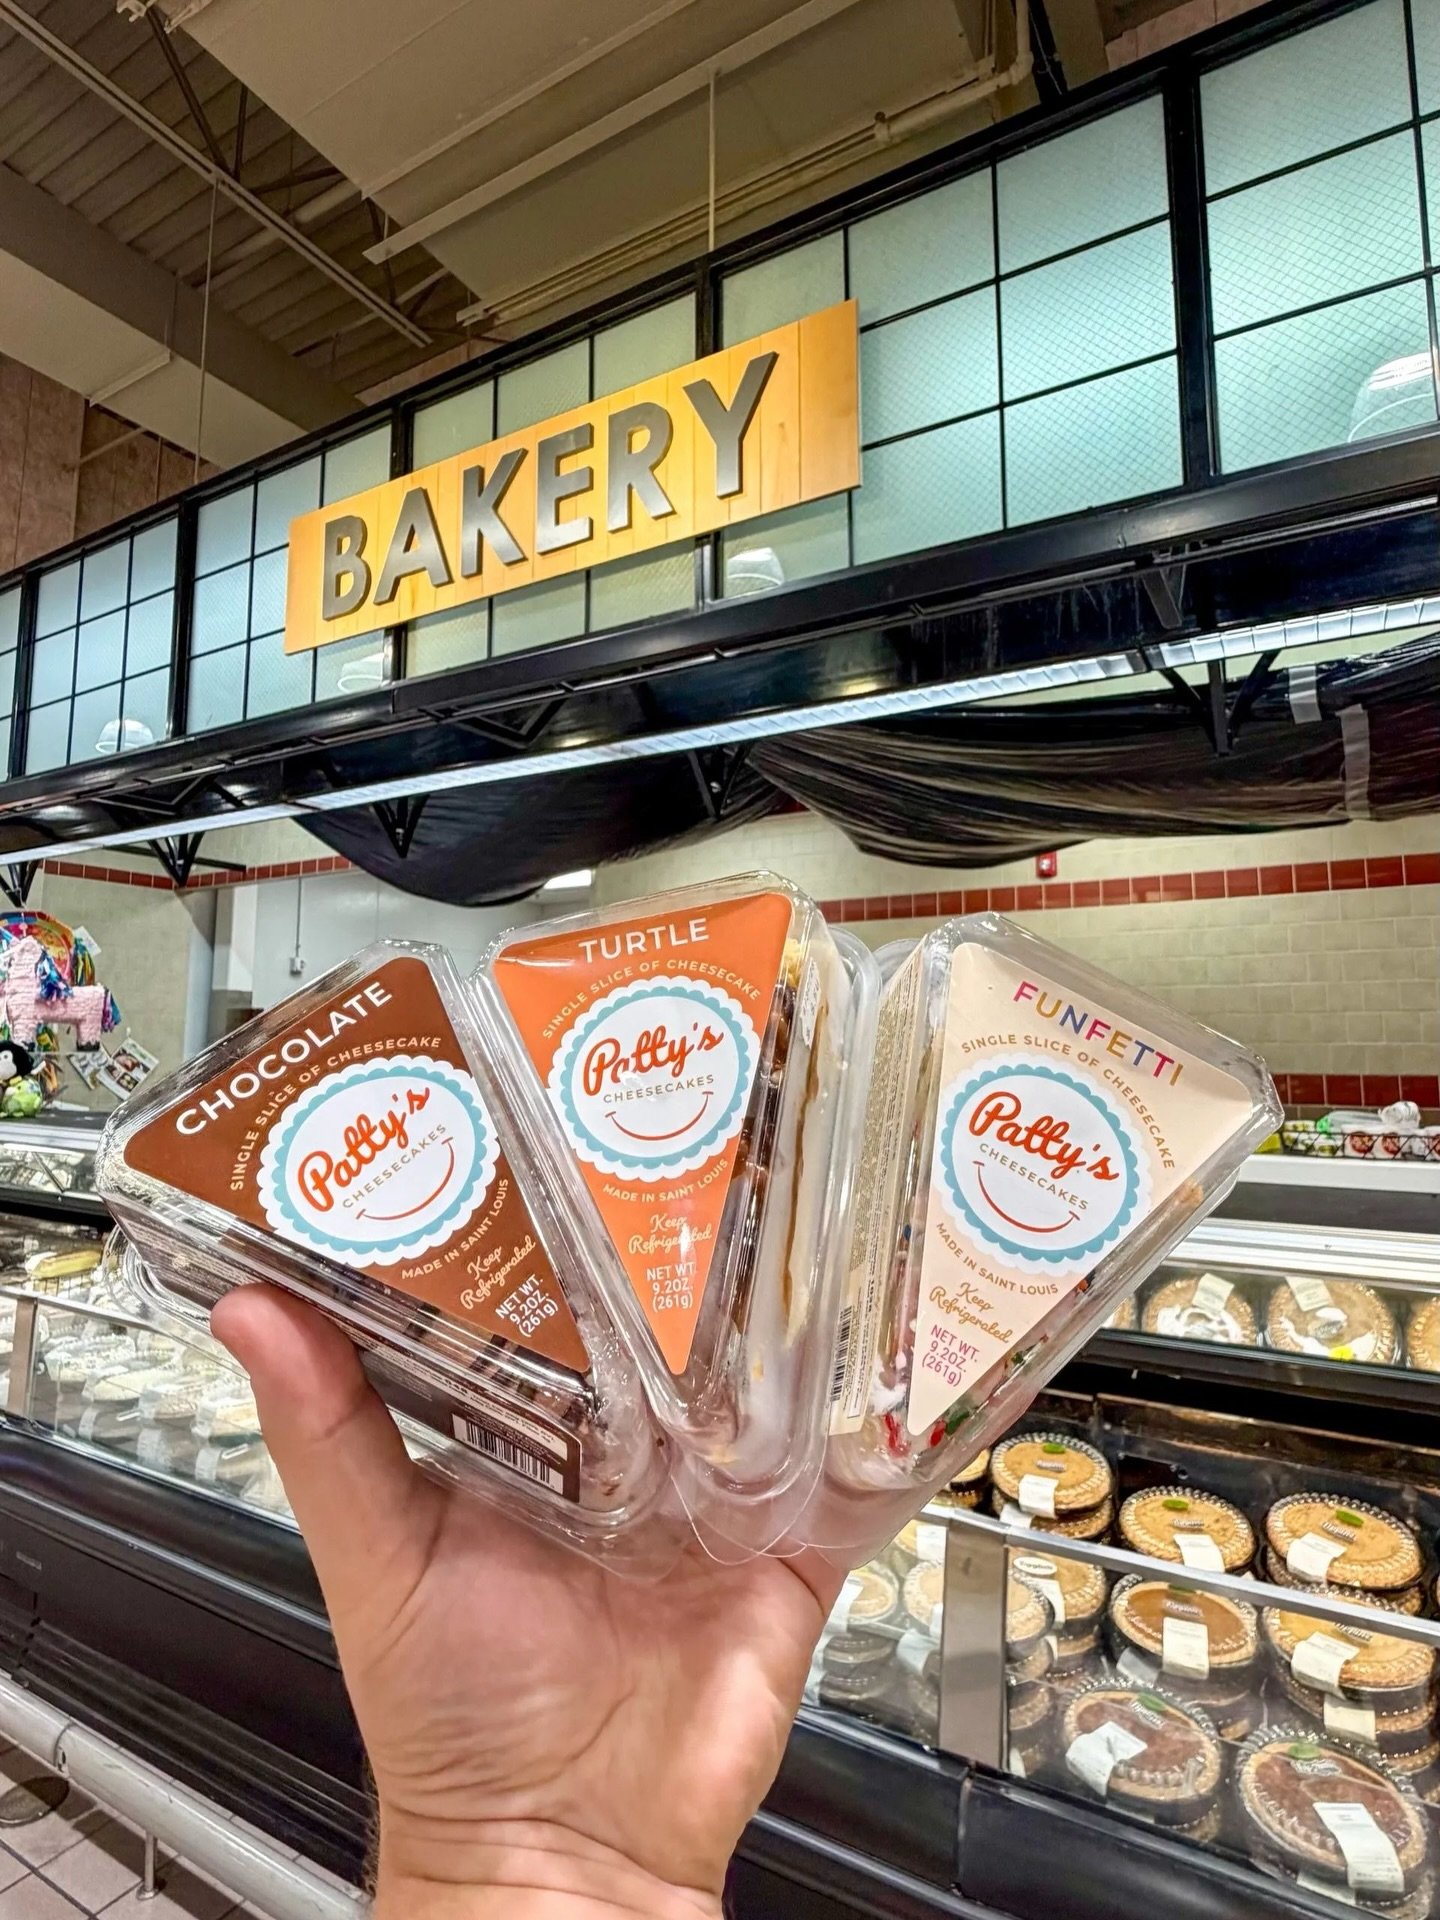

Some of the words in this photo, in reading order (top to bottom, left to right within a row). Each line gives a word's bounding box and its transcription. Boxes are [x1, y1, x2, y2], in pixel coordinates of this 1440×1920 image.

[321, 351, 779, 622] BAKERY
[578, 918, 709, 964] TURTLE
[542, 993, 588, 1039] SINGLE
[590, 966, 634, 993] SLICE
[639, 960, 661, 973] OF
[666, 959, 761, 1001] CHEESECAKE
[175, 981, 393, 1135] CHOCOLATE
[583, 1022, 724, 1097] Patty's
[1013, 981, 1184, 1087] FUNFETTI
[230, 1130, 259, 1191] SINGLE
[255, 1084, 297, 1127] SLICE
[298, 1064, 322, 1083] OF
[327, 1036, 442, 1067] CHEESECAKE
[603, 1074, 715, 1104] CHEESECAKES
[961, 1034, 1018, 1054] SINGLE
[1023, 1035, 1071, 1056] SLICE
[1076, 1051, 1100, 1069] OF
[1102, 1068, 1176, 1170] CHEESECAKE
[297, 1087, 431, 1213] Patty's
[968, 1091, 1120, 1181] Patty's
[342, 1123, 447, 1209] CHEESECAKES
[602, 1183, 638, 1202] MADE
[641, 1193, 655, 1203] IN
[659, 1183, 695, 1201] SAINT
[697, 1158, 729, 1189] LOUIS
[979, 1143, 1089, 1211] CHEESECAKES
[401, 1258, 443, 1280] MADE
[444, 1248, 460, 1263] IN
[460, 1217, 493, 1252] SAINT
[489, 1178, 509, 1217] LOUIS
[650, 1213, 688, 1234] Keep
[459, 1234, 537, 1310] Refrigerated
[466, 1245, 502, 1281] Keep
[646, 1265, 672, 1282] NET
[936, 1222, 963, 1258] MADE
[963, 1255, 978, 1271] IN
[978, 1266, 1017, 1292] SAINT
[1019, 1283, 1059, 1296] LOUIS
[494, 1291, 522, 1320] NET
[518, 1273, 544, 1296] WT.
[509, 1289, 550, 1325] 9.2OZ.
[518, 1297, 559, 1338] (261g)
[652, 1290, 694, 1313] (261g)
[929, 1285, 1014, 1344] Refrigerated
[955, 1281, 995, 1312] Keep
[921, 1352, 963, 1387] (261g)
[929, 1340, 967, 1373] 9.2OZ.
[930, 1324, 958, 1347] NET
[958, 1339, 980, 1363] WT.
